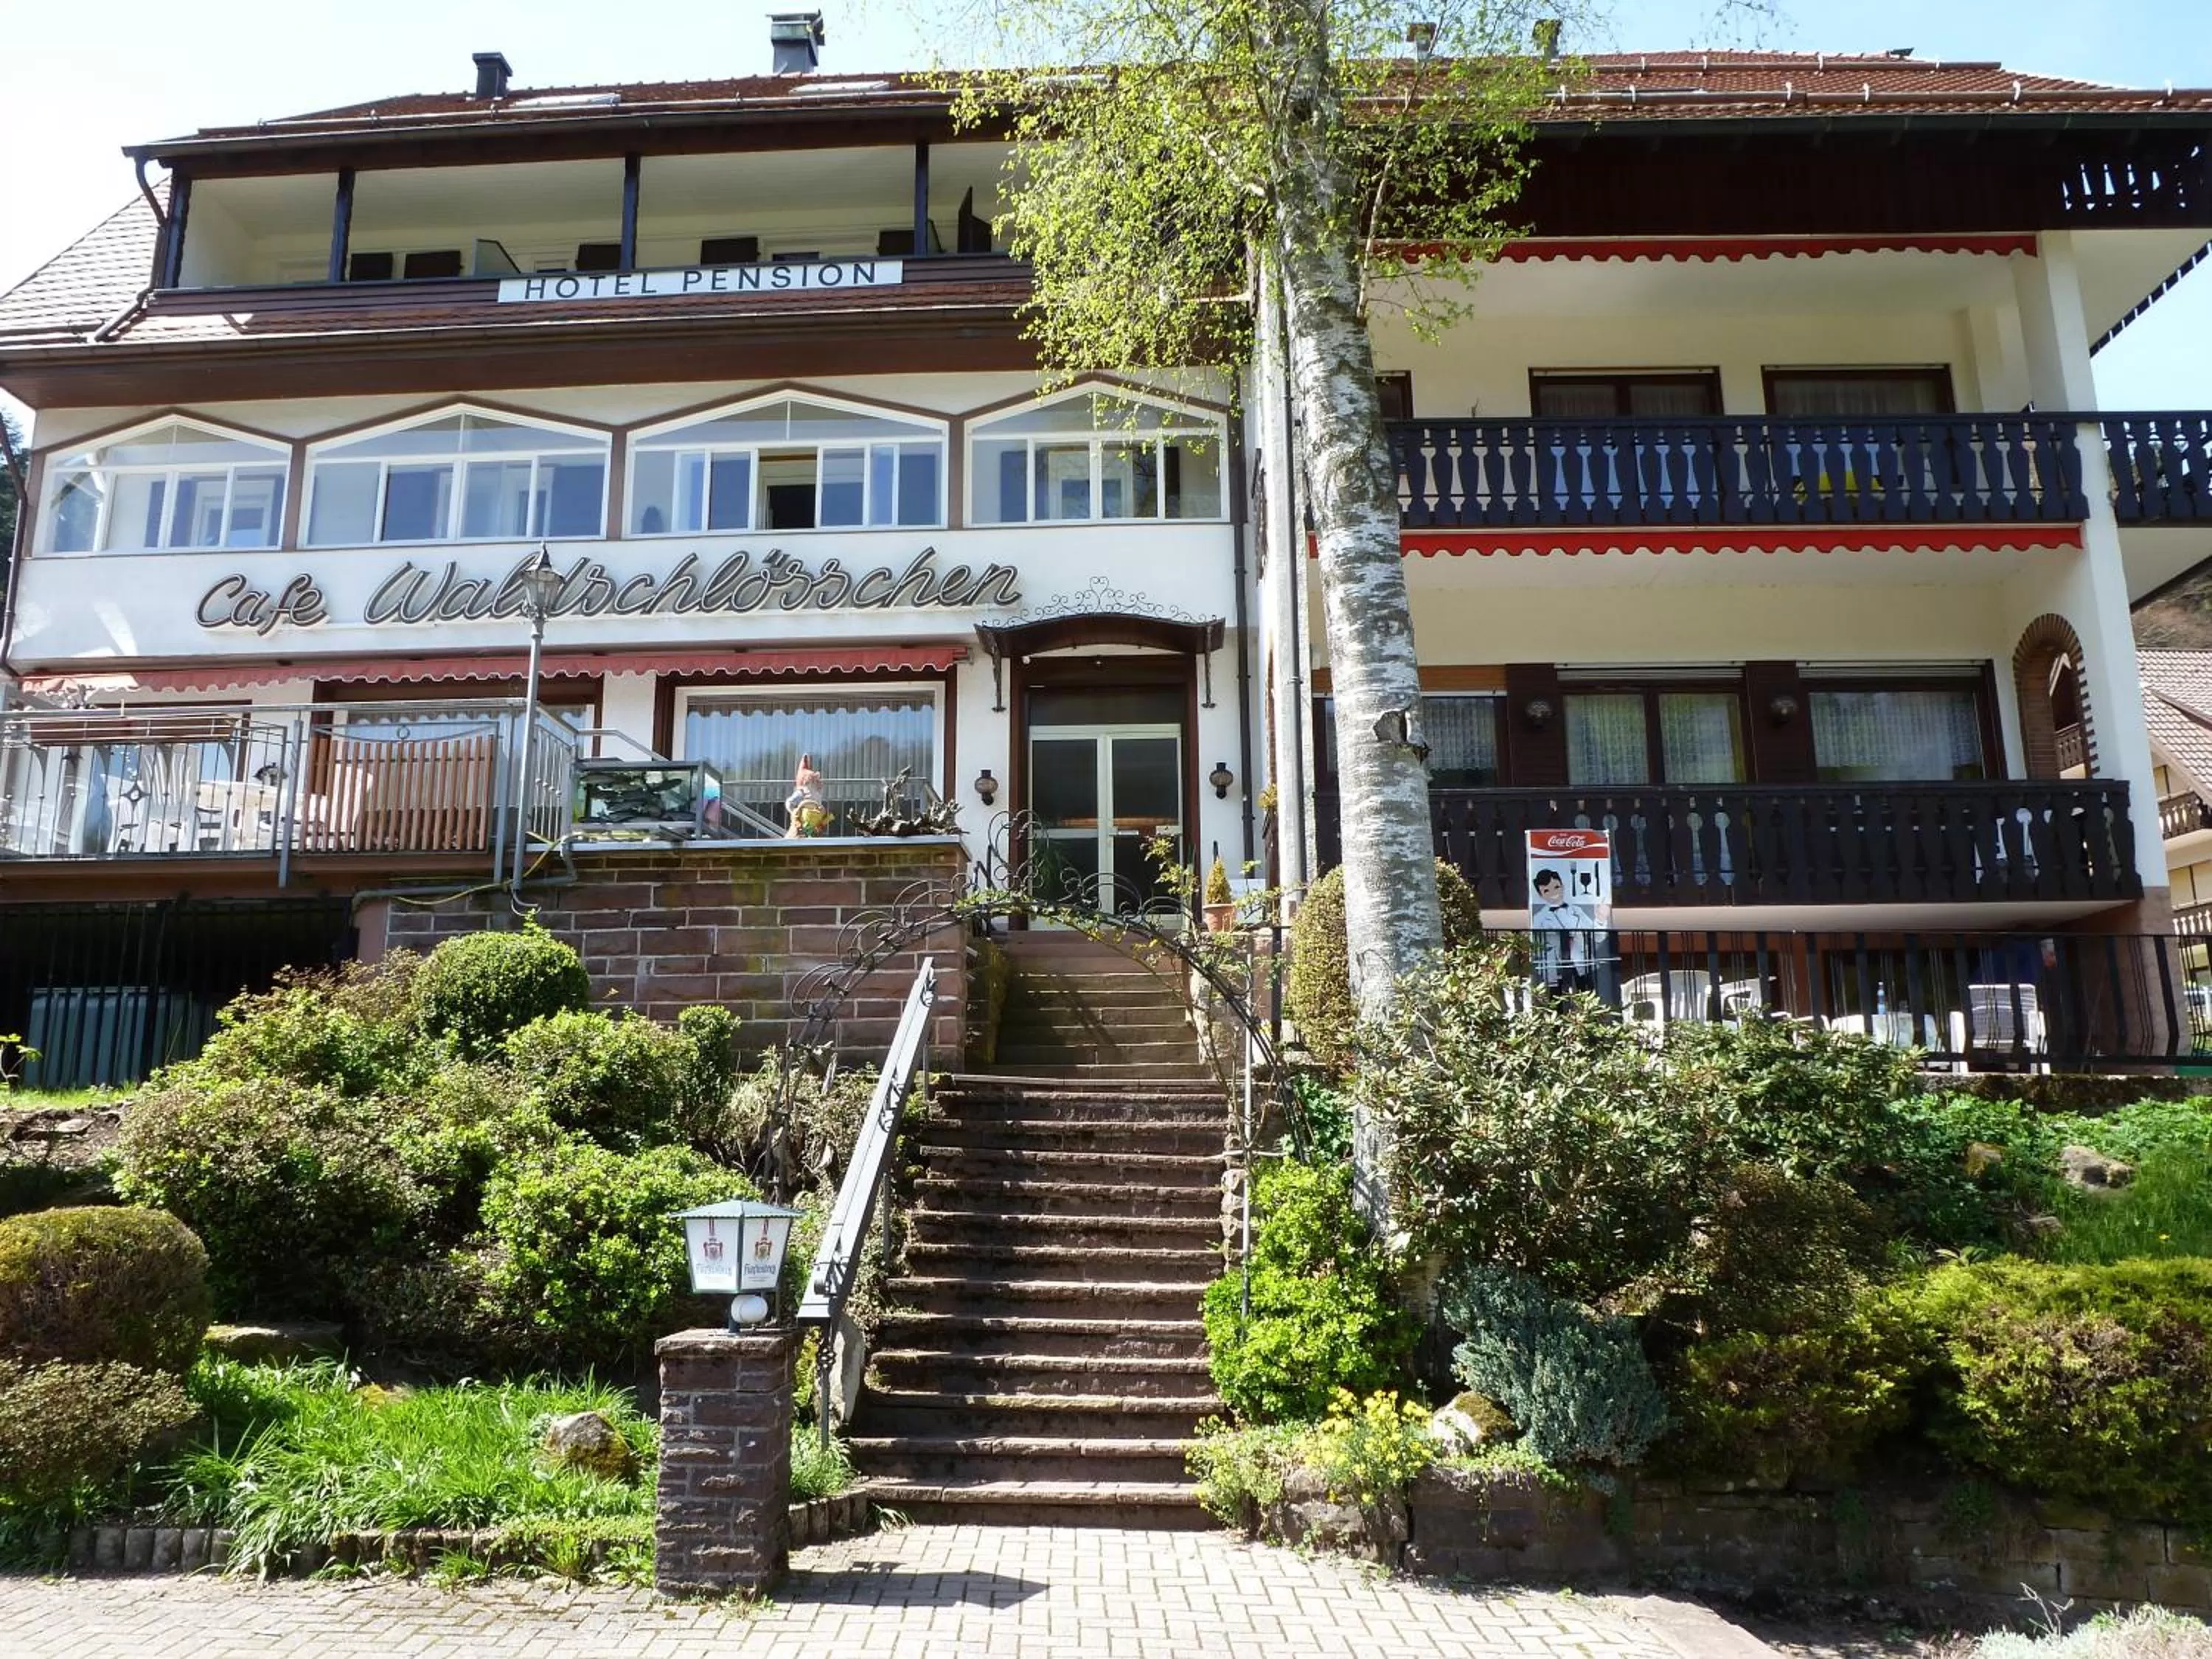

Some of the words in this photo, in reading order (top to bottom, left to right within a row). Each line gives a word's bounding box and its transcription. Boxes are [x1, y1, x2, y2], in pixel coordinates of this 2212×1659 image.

[524, 272, 657, 300] HOTEL
[683, 262, 875, 291] PENSION
[195, 572, 328, 638] Cafe
